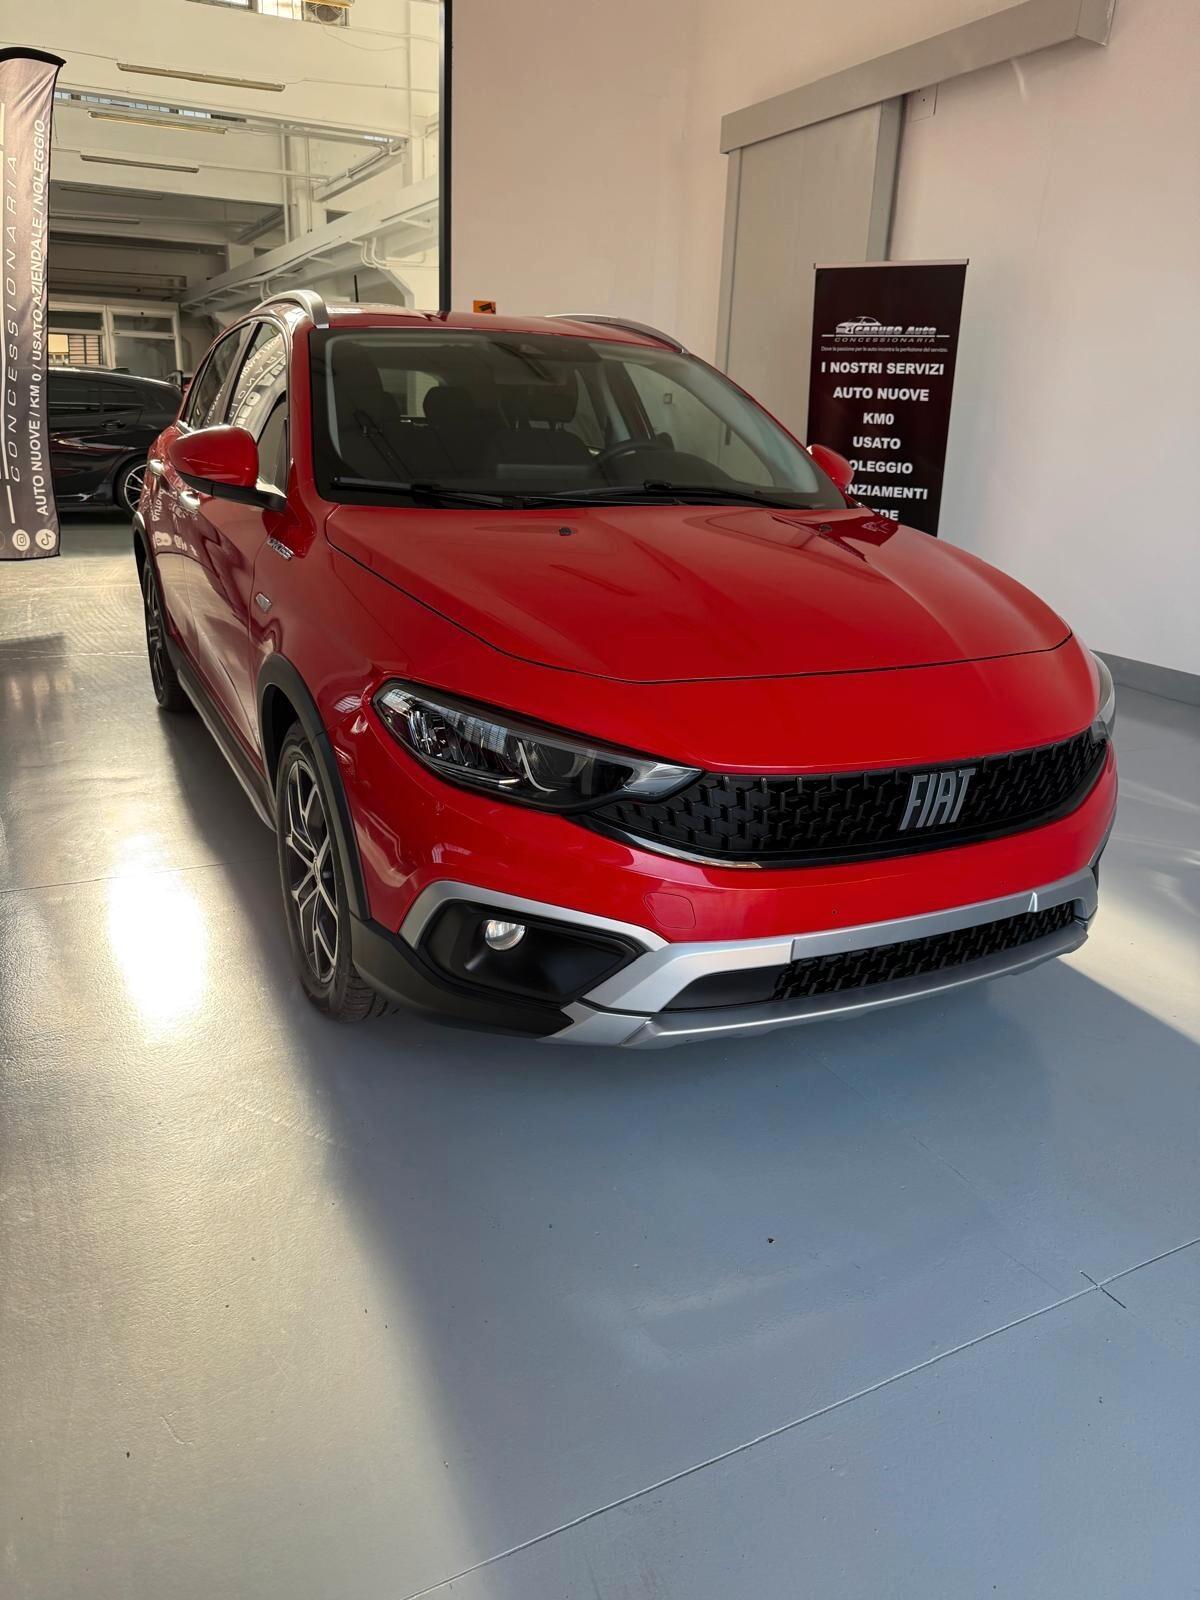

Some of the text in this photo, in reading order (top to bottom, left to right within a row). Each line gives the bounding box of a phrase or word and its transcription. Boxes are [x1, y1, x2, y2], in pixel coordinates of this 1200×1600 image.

[32, 119, 46, 207] NOLEGGIO
[31, 216, 43, 303] AZIENDALE
[6, 156, 20, 483] CONCESSIONARIA
[31, 303, 43, 361] USATO
[31, 372, 41, 382] 0
[820, 361, 945, 376] I NOSTRI SERVIZI
[29, 384, 40, 409] KM
[832, 386, 930, 402] AUTO NUOVE
[862, 412, 895, 425] KM0
[28, 419, 42, 473] NUOVE
[852, 436, 901, 450] USATO
[849, 459, 913, 475] OLEGGIO
[32, 473, 49, 516] AUTO
[845, 484, 928, 500] NZIAMENTI
[899, 768, 977, 831] FIAT
